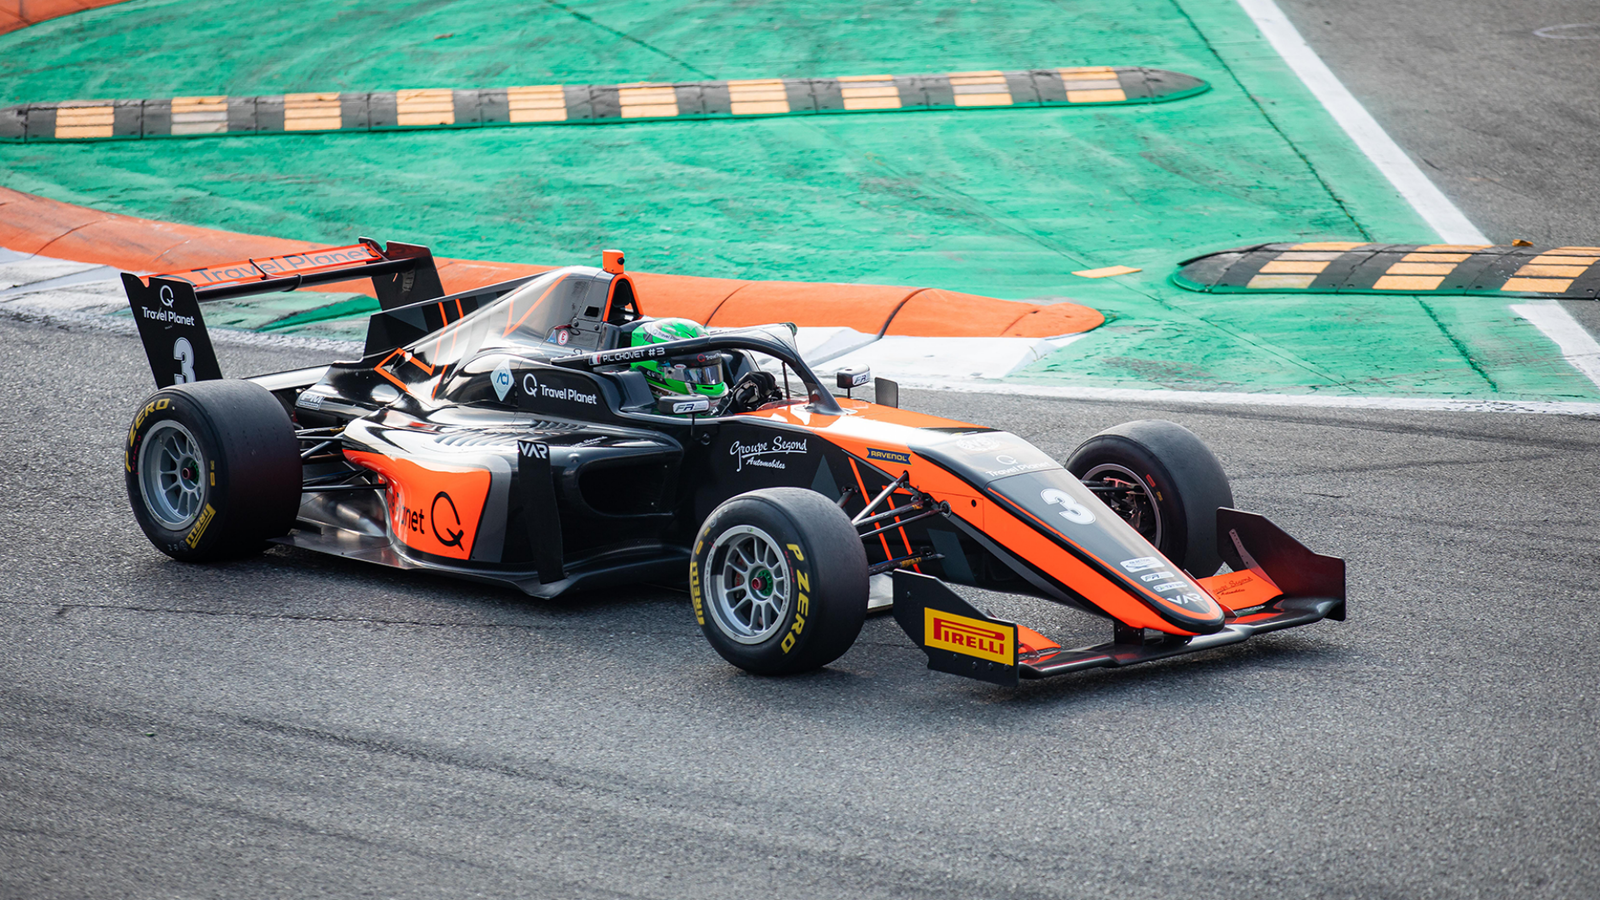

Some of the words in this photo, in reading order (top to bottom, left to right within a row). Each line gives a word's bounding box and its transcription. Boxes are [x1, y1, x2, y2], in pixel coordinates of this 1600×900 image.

[190, 258, 286, 284] Travel
[283, 246, 374, 268] Planet
[141, 306, 168, 322] Travel
[168, 311, 195, 327] Planet
[173, 336, 197, 386] 3
[540, 384, 567, 400] Travel
[567, 389, 597, 405] Planet
[127, 398, 171, 447] ZERO
[519, 441, 547, 459] VAR
[729, 440, 768, 472] Groupe
[746, 456, 786, 470] Automobiles
[870, 450, 907, 462] RAVENOL
[985, 466, 1021, 478] Travel
[1017, 460, 1054, 474] Planet
[1040, 488, 1097, 525] 3
[689, 561, 706, 625] PIRELLI
[781, 568, 811, 654] ZERO
[933, 617, 1005, 655] PIRELLI
